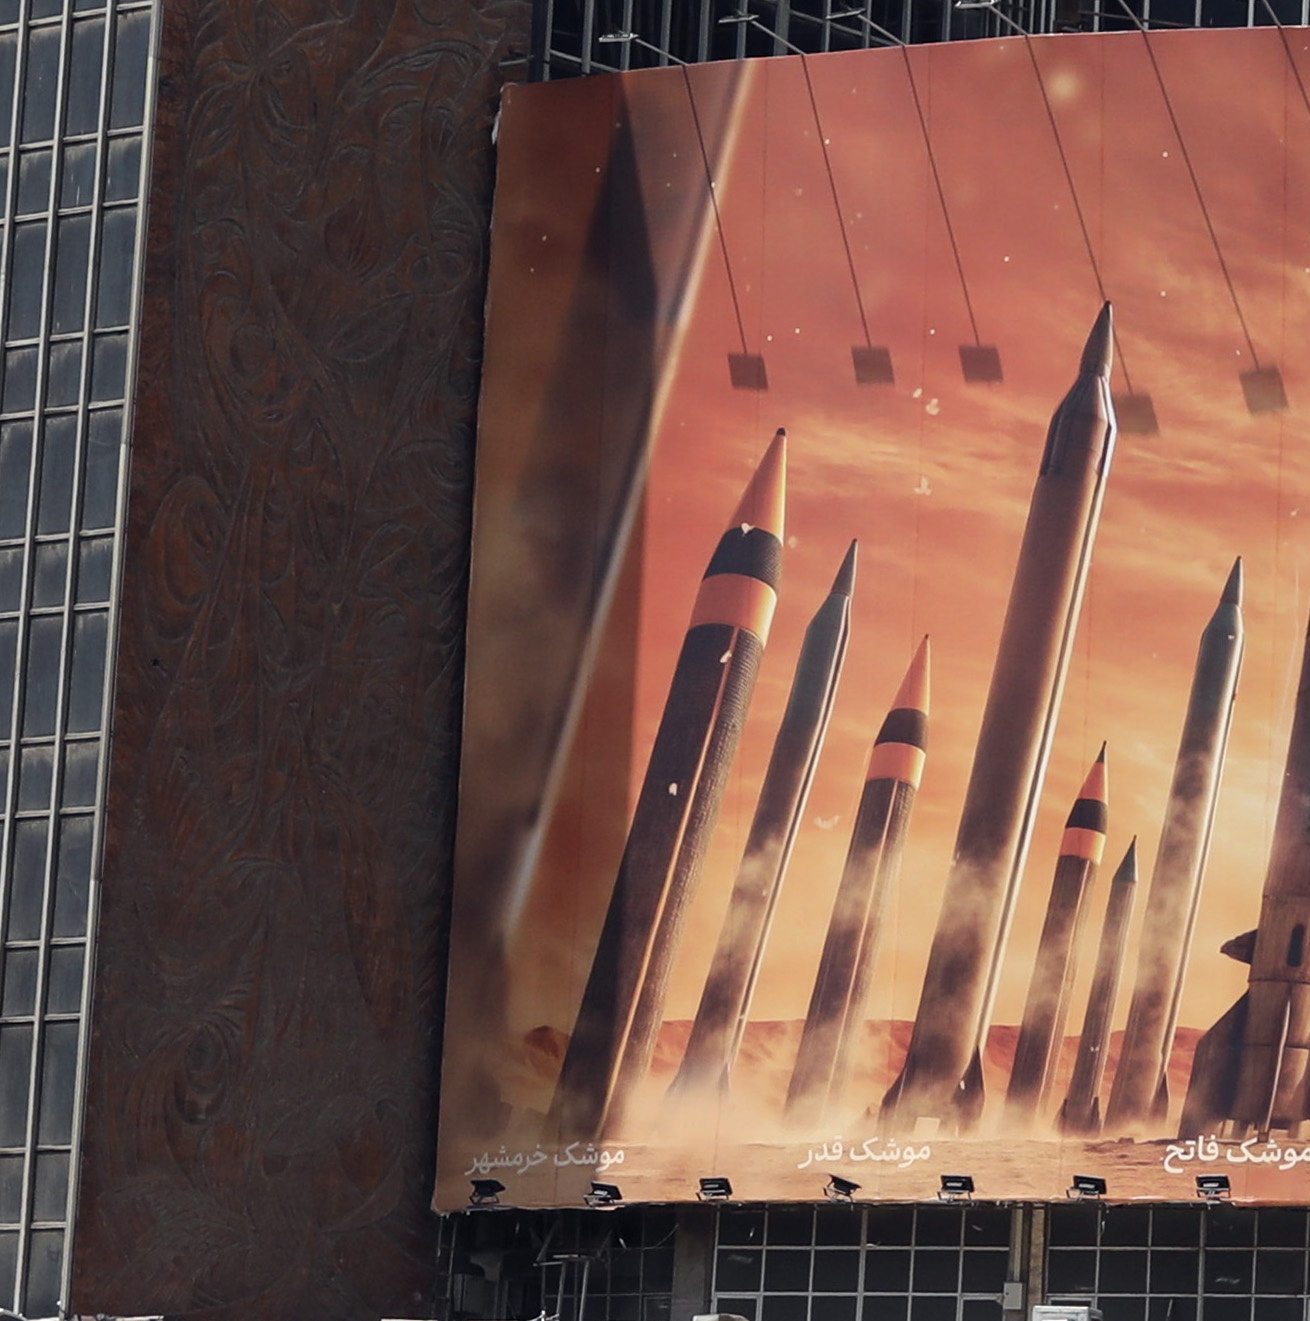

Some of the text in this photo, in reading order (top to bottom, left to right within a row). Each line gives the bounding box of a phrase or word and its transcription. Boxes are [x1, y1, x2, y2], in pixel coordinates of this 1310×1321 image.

[464, 1142, 626, 1176] موشک خرمشهر
[797, 1136, 931, 1170] موشک قدر
[1163, 1136, 1220, 1174] فاتح
